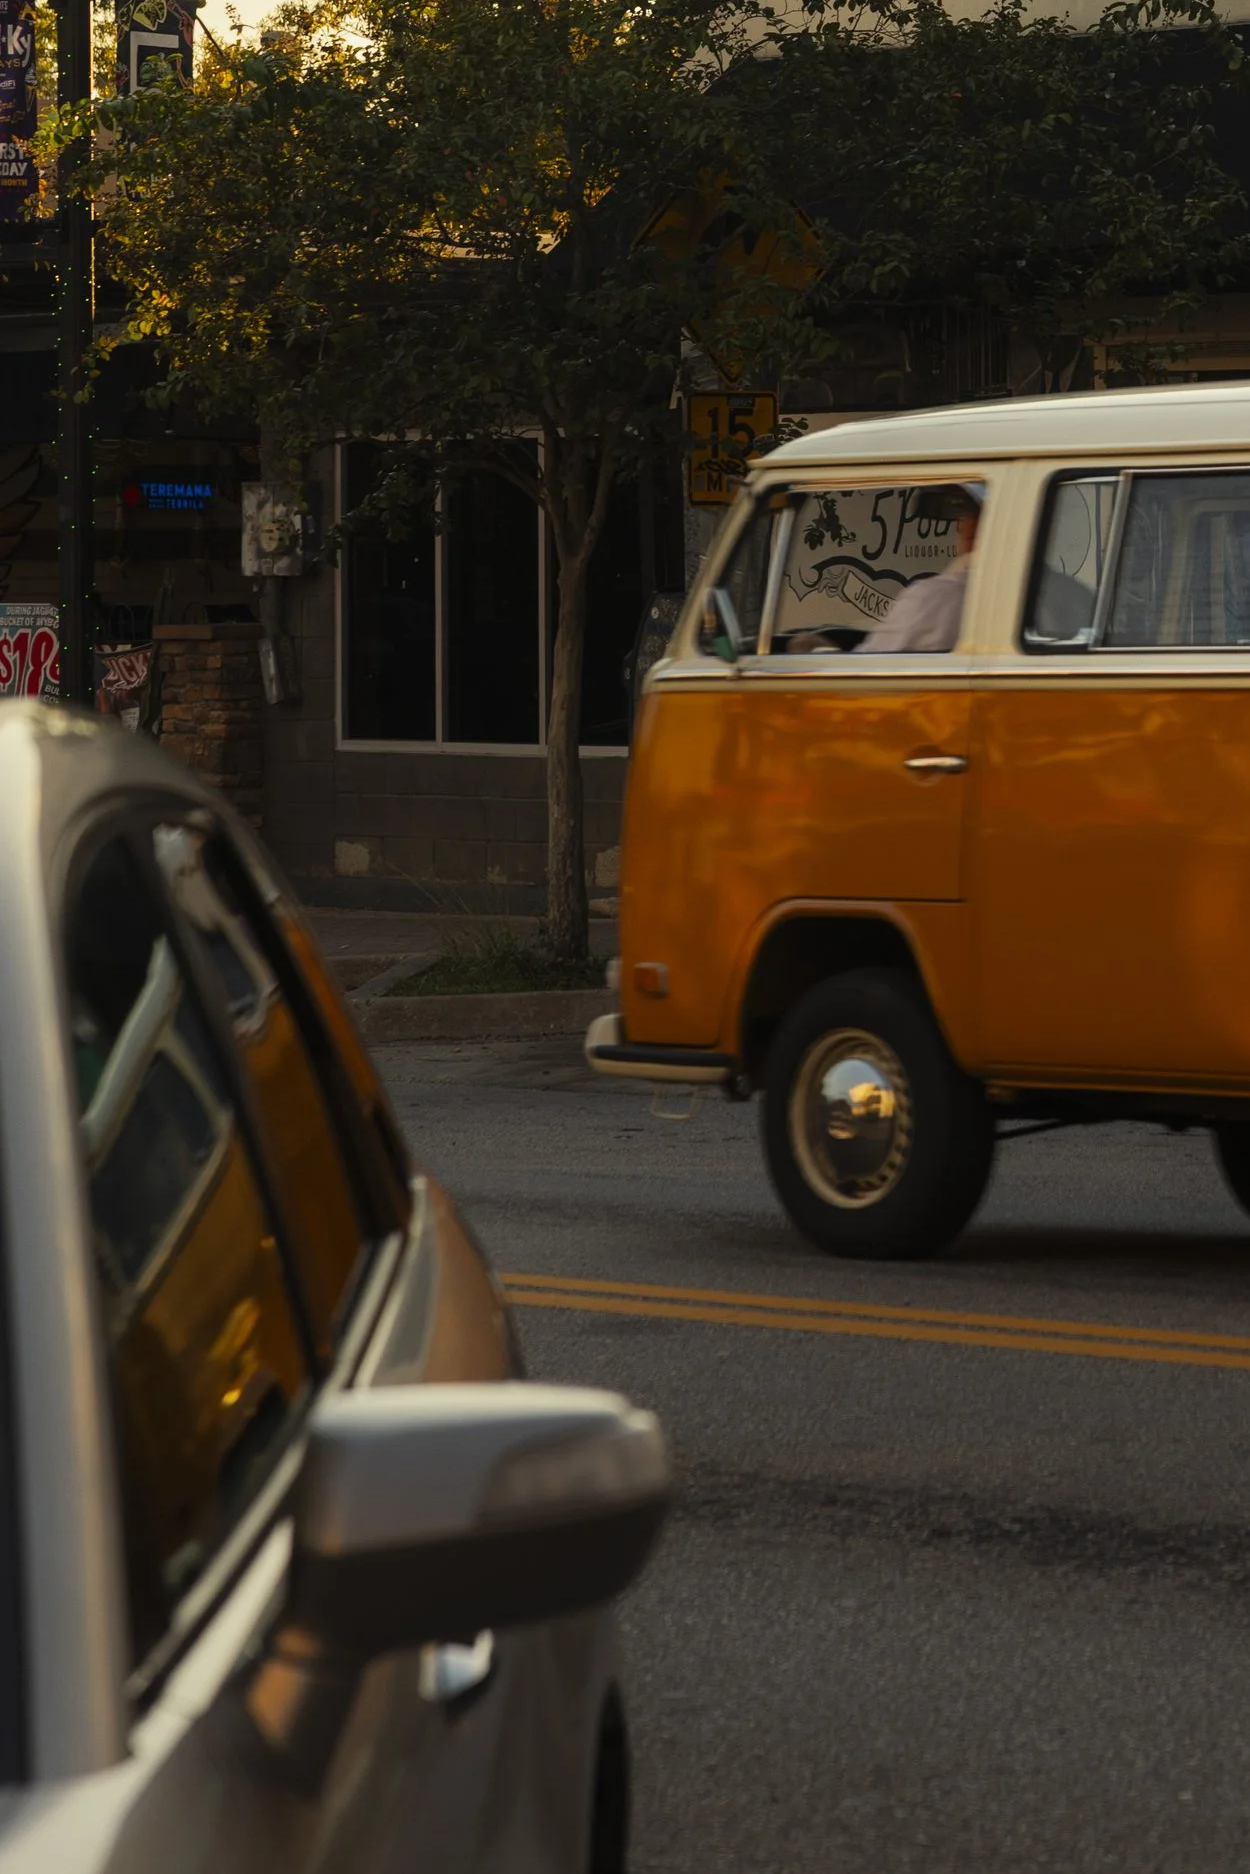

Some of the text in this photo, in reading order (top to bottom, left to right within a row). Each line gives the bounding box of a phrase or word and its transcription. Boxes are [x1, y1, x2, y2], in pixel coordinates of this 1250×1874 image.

[706, 407, 756, 460] 15
[140, 482, 213, 498] TEREMANA
[166, 498, 204, 510] TEQUILA
[904, 544, 939, 558] LIQUOR
[6, 606, 32, 616] DURING
[24, 617, 34, 626] OF
